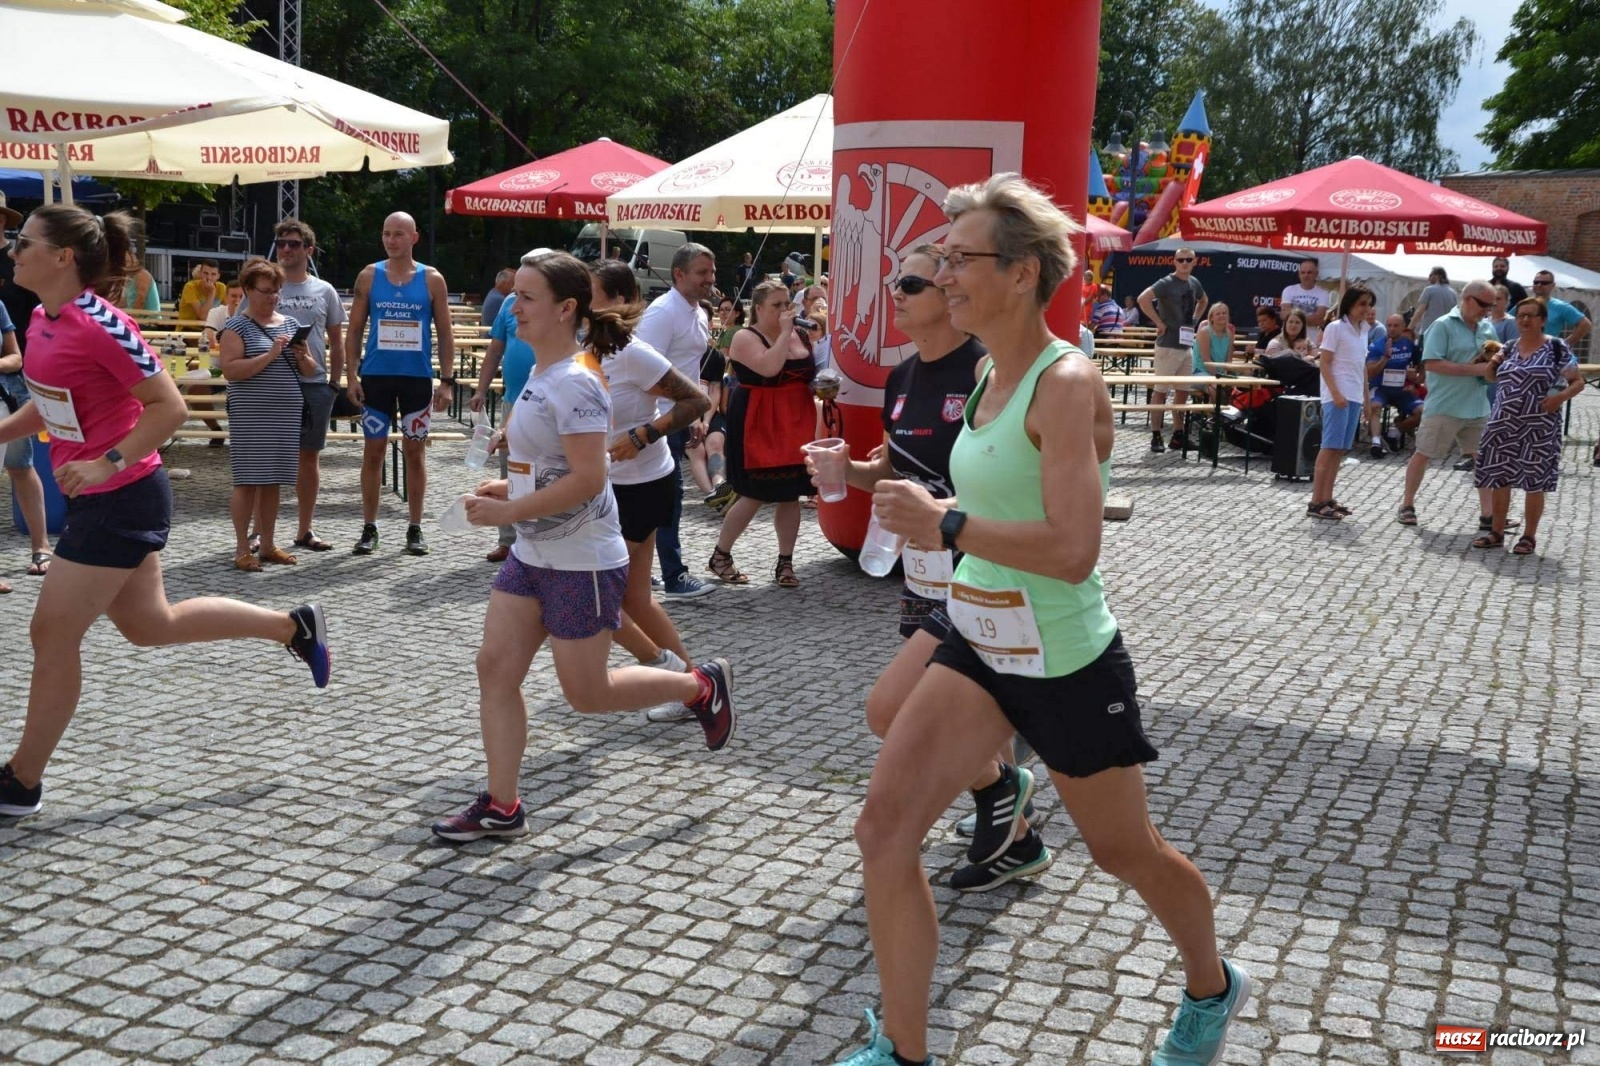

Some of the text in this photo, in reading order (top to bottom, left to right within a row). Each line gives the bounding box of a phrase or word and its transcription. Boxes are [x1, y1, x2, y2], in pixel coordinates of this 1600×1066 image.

[464, 196, 546, 215] RACIBORSKIE
[617, 204, 702, 222] RACIBORSKIE
[1190, 216, 1278, 232] RACIBORSKIE
[1304, 217, 1430, 237] RACIBORSKIE
[1463, 223, 1537, 245] RACIBORSKIE
[1237, 258, 1259, 268] SKLEP
[376, 301, 422, 311] WODZISŁAW
[384, 309, 412, 319] ŚLĄSKI
[394, 330, 405, 339] 16
[912, 557, 927, 575] 25
[976, 616, 998, 640] 19
